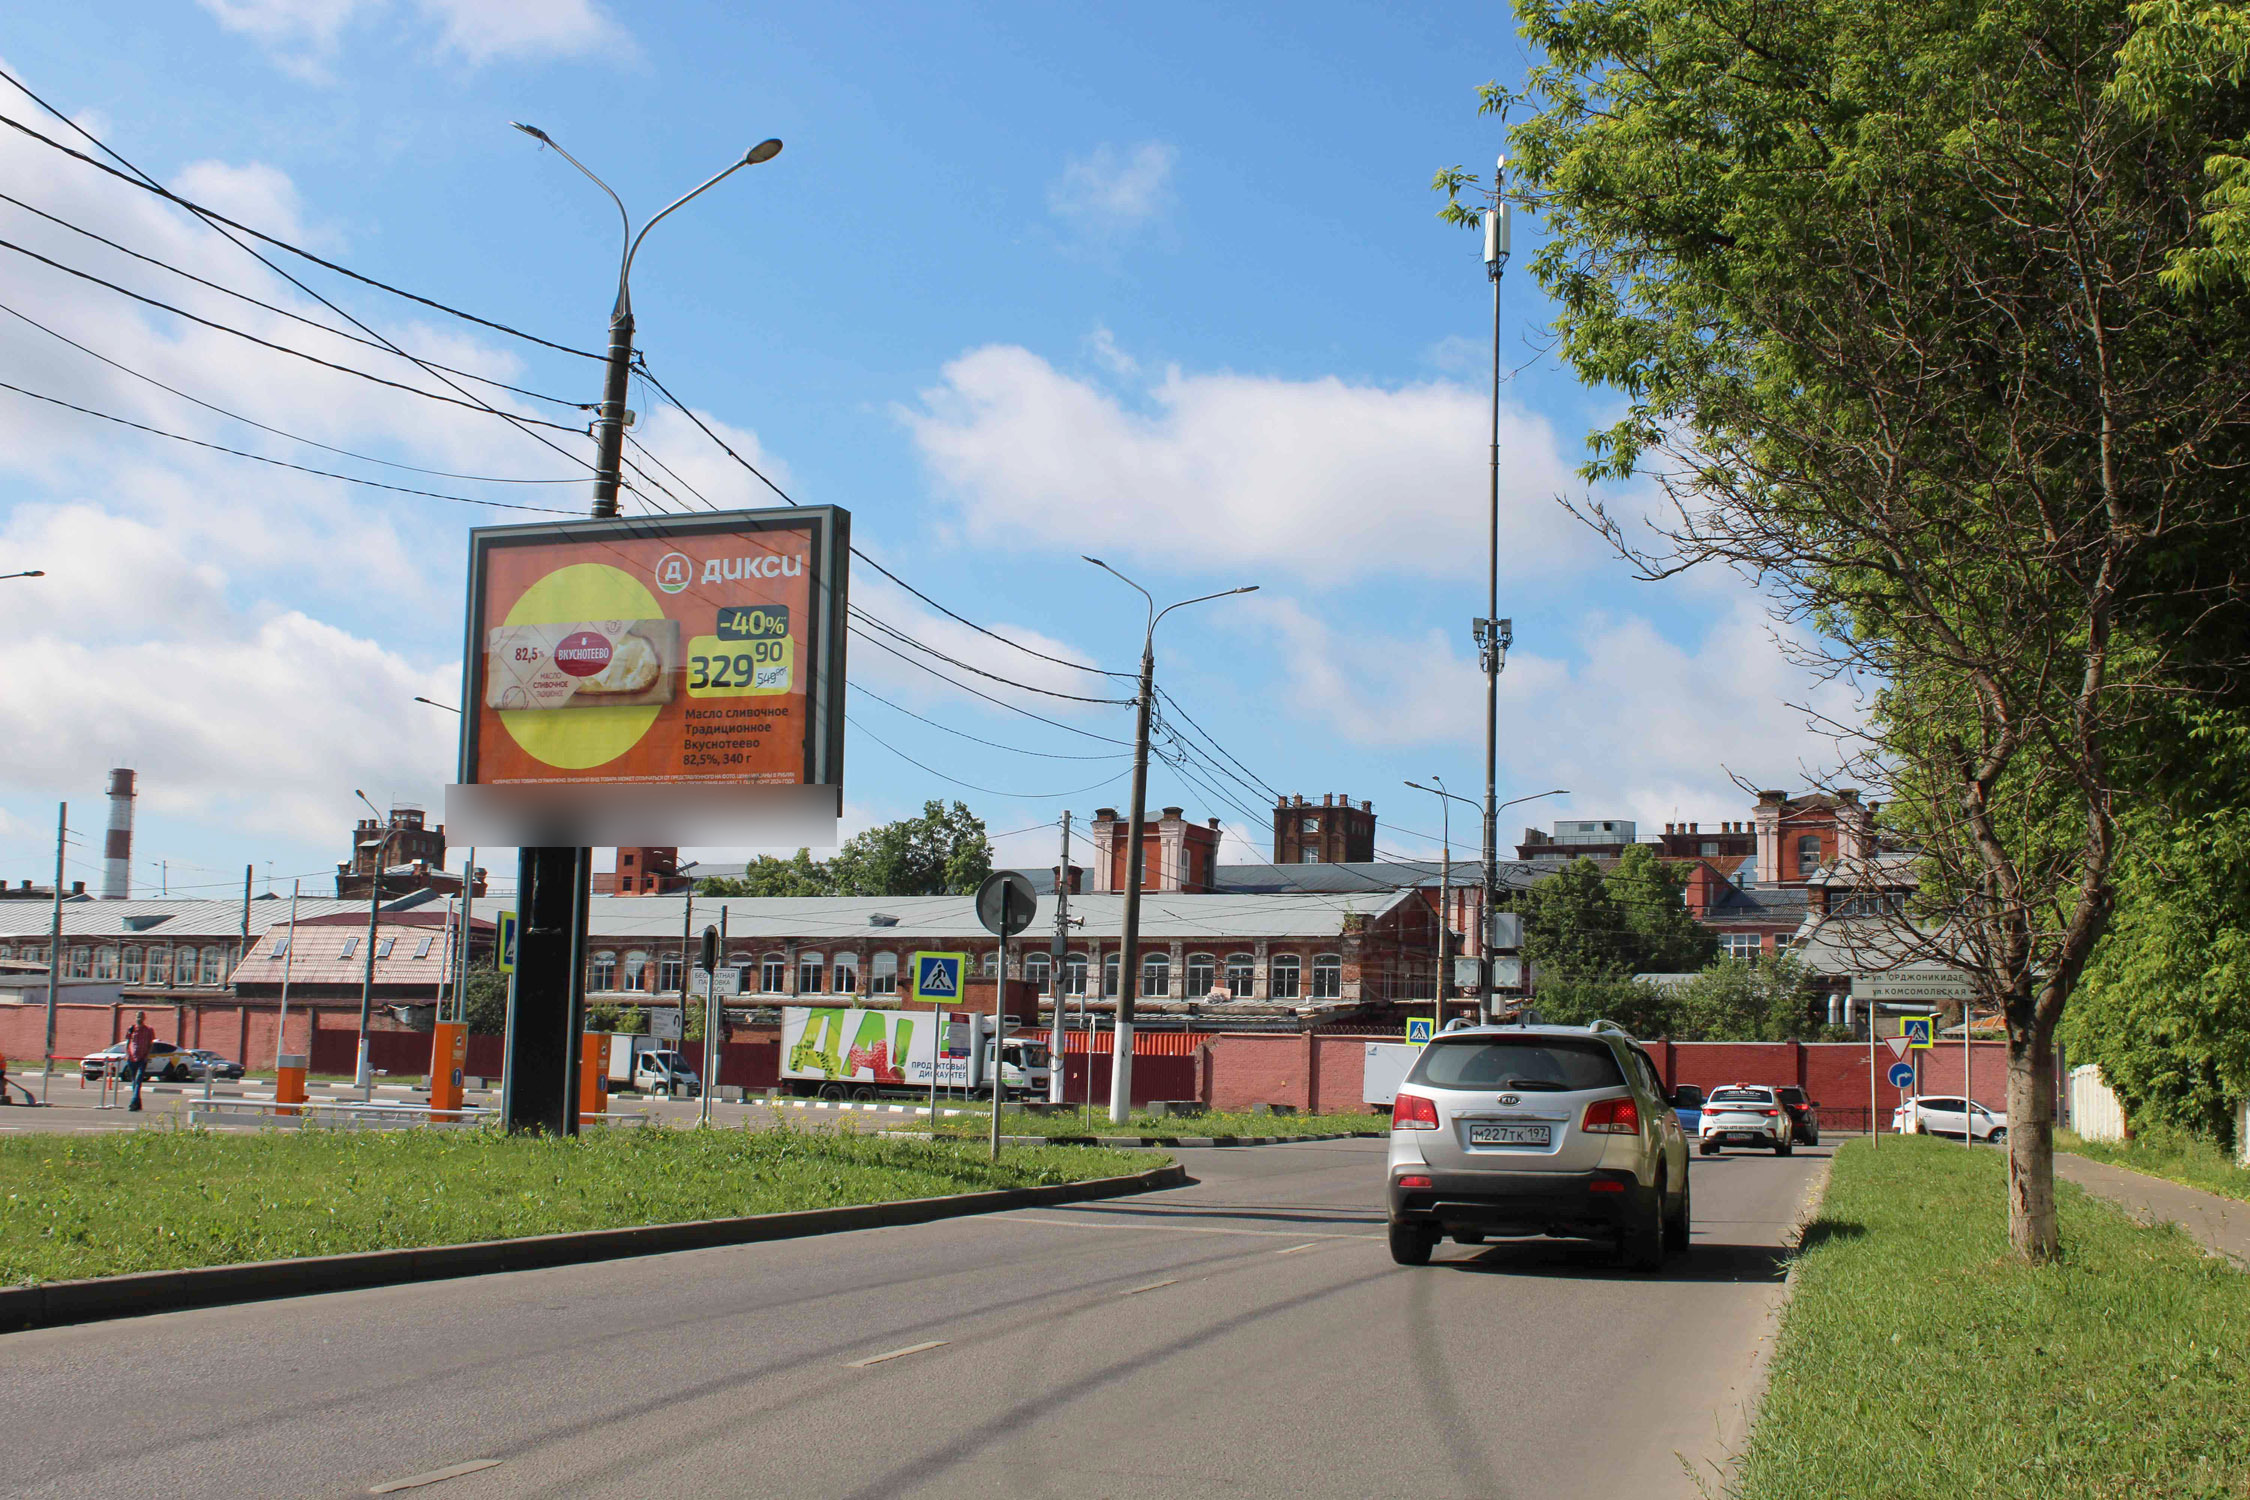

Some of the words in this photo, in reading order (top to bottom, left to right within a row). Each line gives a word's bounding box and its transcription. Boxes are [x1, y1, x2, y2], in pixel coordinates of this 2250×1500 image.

[558, 647, 609, 660] ВКУСНОТЕЕВО
[689, 654, 754, 689] 329
[755, 641, 783, 663] 90
[541, 672, 562, 680] МАСЛО
[685, 709, 723, 719] Масло
[725, 708, 789, 718] сливочное
[685, 723, 772, 736] Традиционное
[684, 739, 760, 752] Вкуснотеево
[722, 753, 744, 764] 340
[911, 1062, 967, 1071] ПРОДКТОВЫЙ
